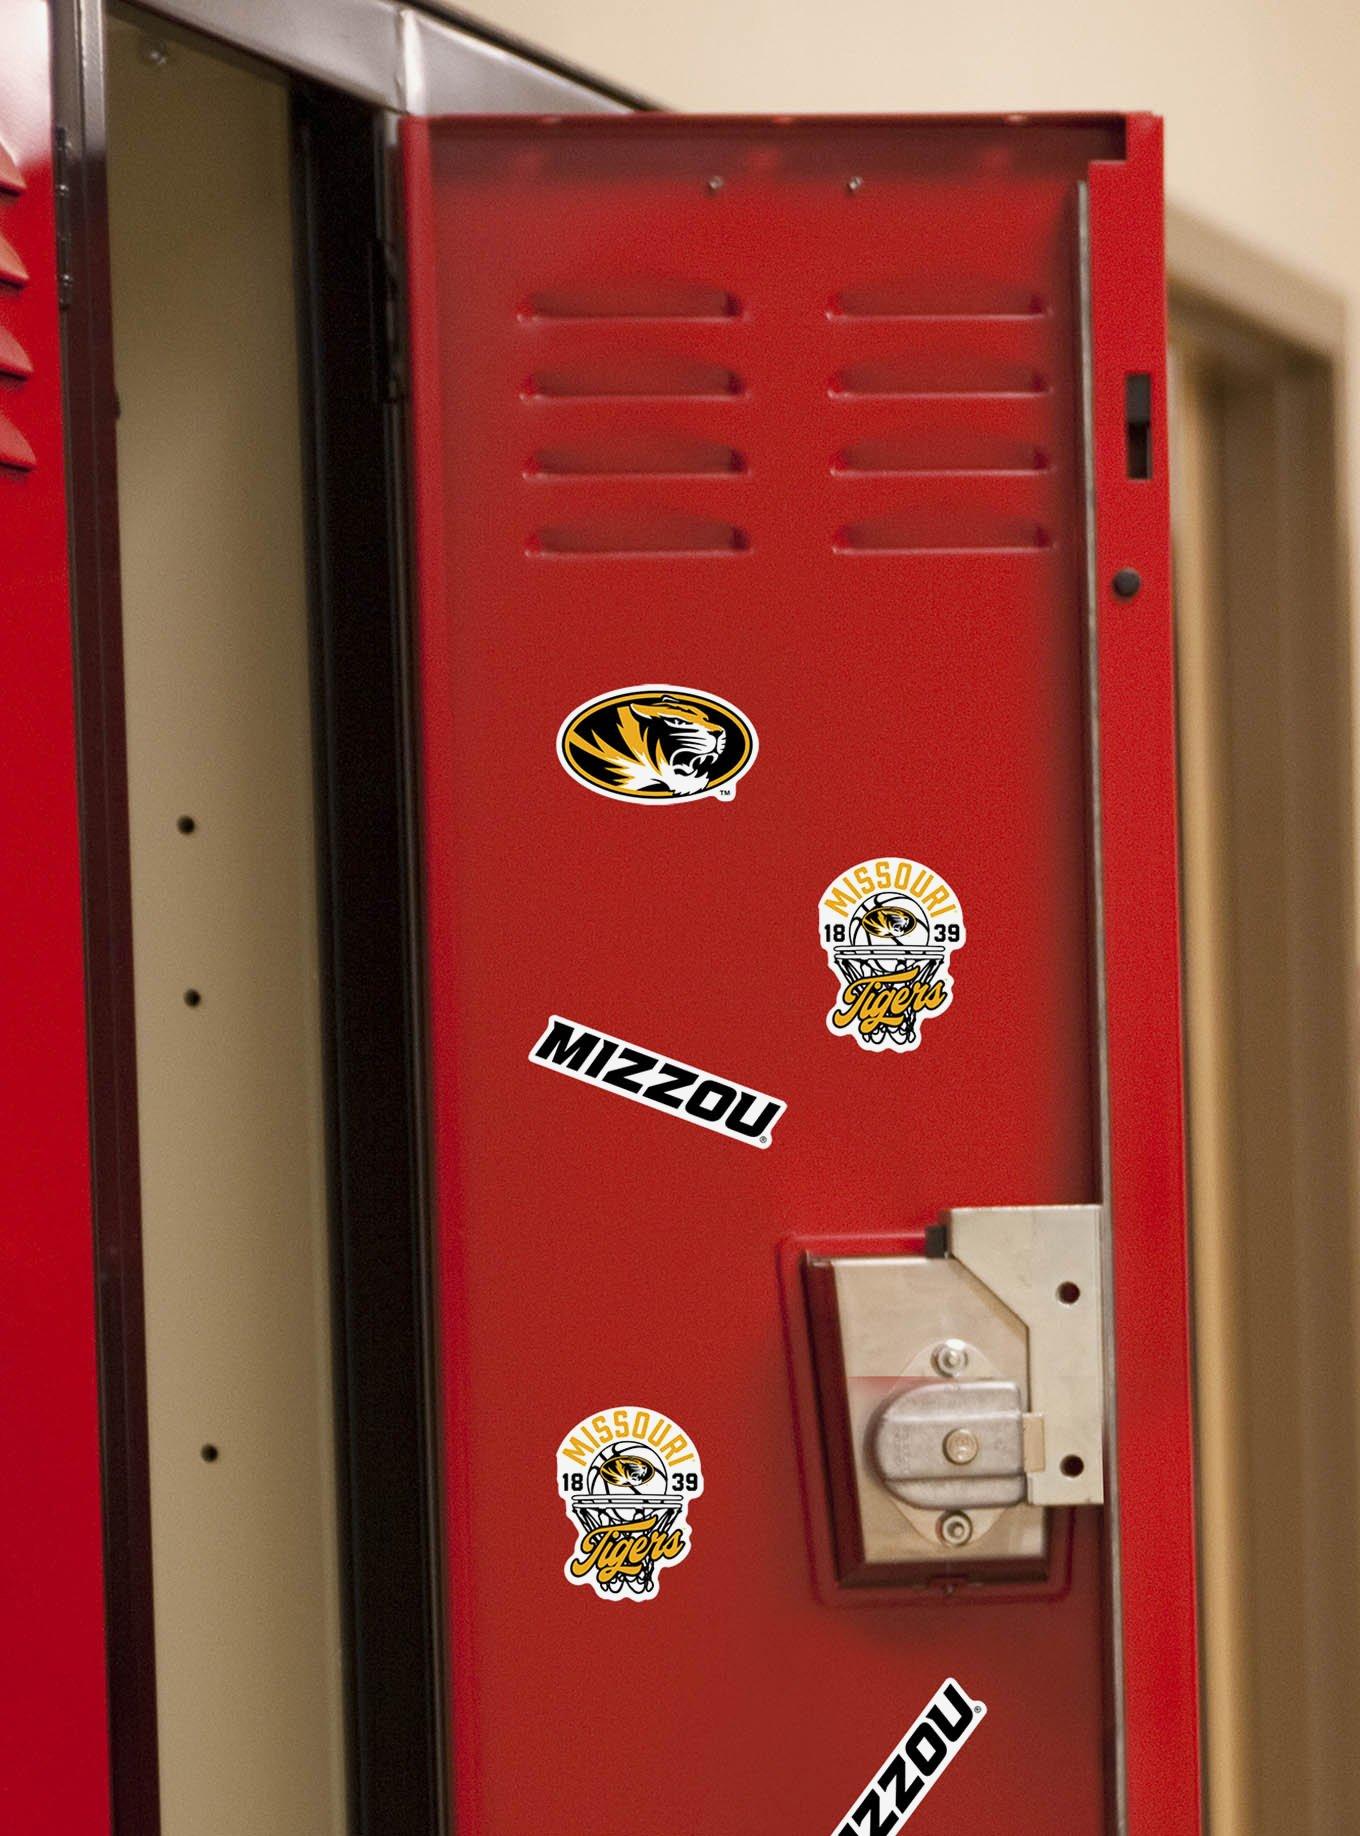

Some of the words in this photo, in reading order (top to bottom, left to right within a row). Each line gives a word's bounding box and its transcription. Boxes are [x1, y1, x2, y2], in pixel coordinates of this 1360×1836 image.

[824, 861, 956, 918] MISSOURI
[824, 924, 846, 943] 18
[934, 924, 960, 943] 39
[832, 965, 948, 1035] Tigers
[535, 1020, 781, 1138] MIZZOU
[562, 1410, 695, 1467] MISSOURI
[562, 1473, 584, 1492] 18
[671, 1473, 698, 1492] 39
[570, 1514, 685, 1584] Tigers
[838, 1683, 974, 1836] ZZOU
